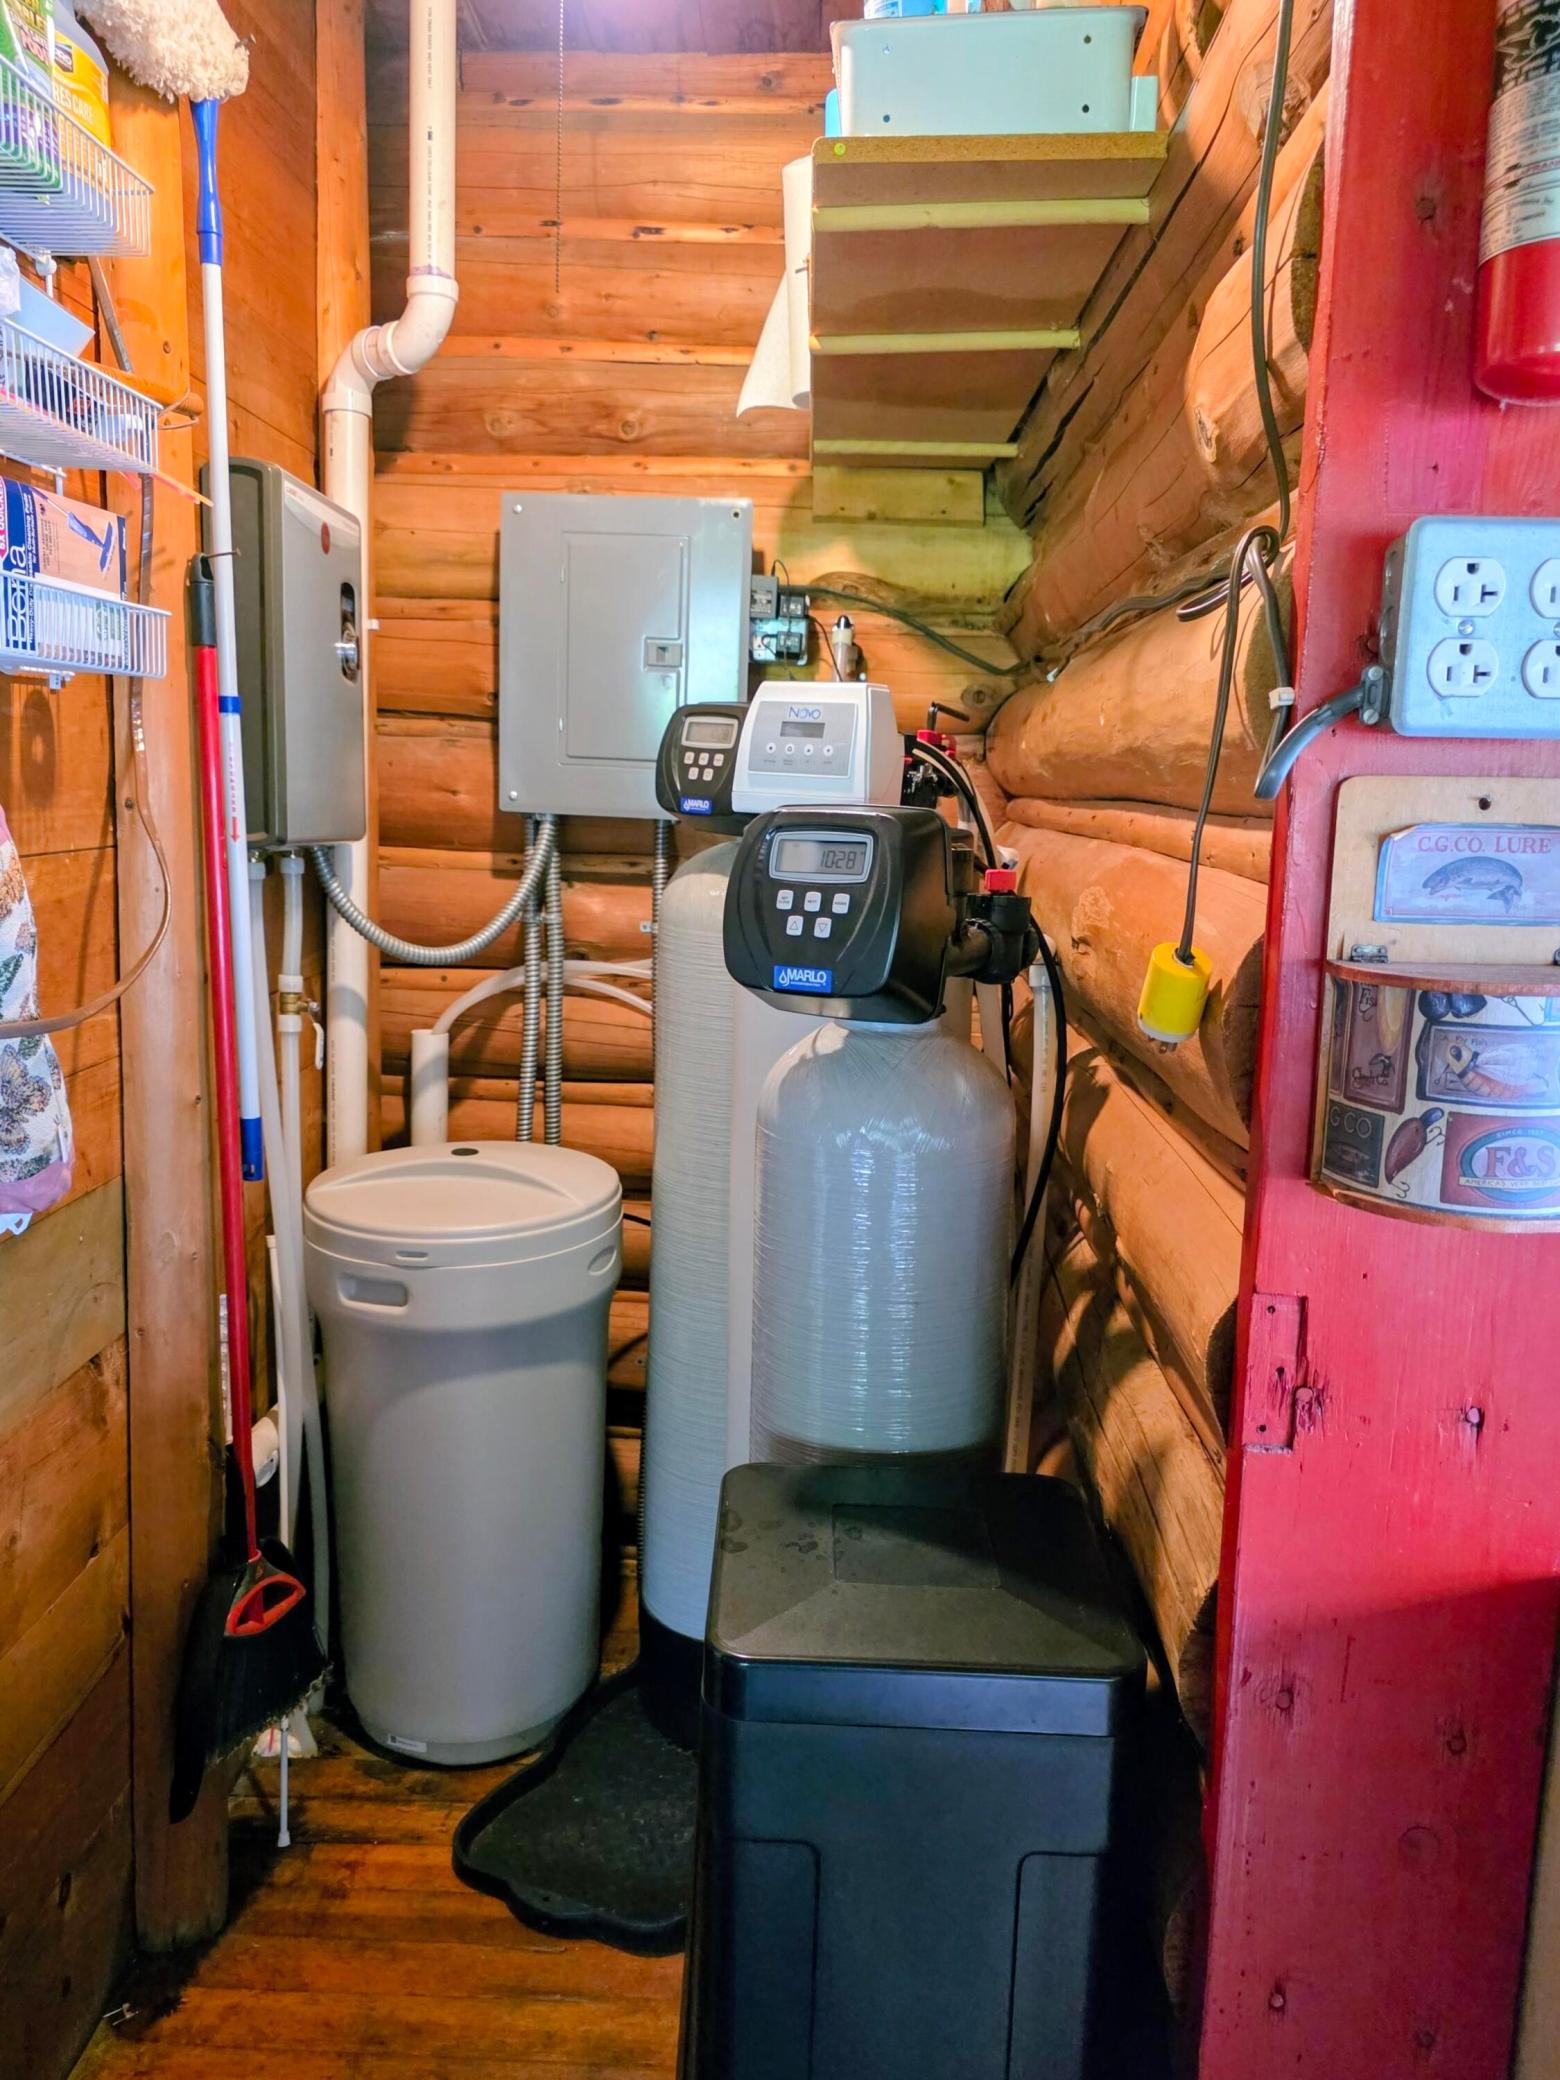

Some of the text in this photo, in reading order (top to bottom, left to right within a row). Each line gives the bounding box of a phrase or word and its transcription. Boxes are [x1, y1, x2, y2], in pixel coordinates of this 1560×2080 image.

[7, 544, 27, 642] Bona
[687, 798, 710, 809] MARLO
[1494, 836, 1552, 854] LURE
[787, 968, 827, 983] MARLO
[1343, 1112, 1373, 1139] CO
[1483, 1145, 1555, 1178] F&S
